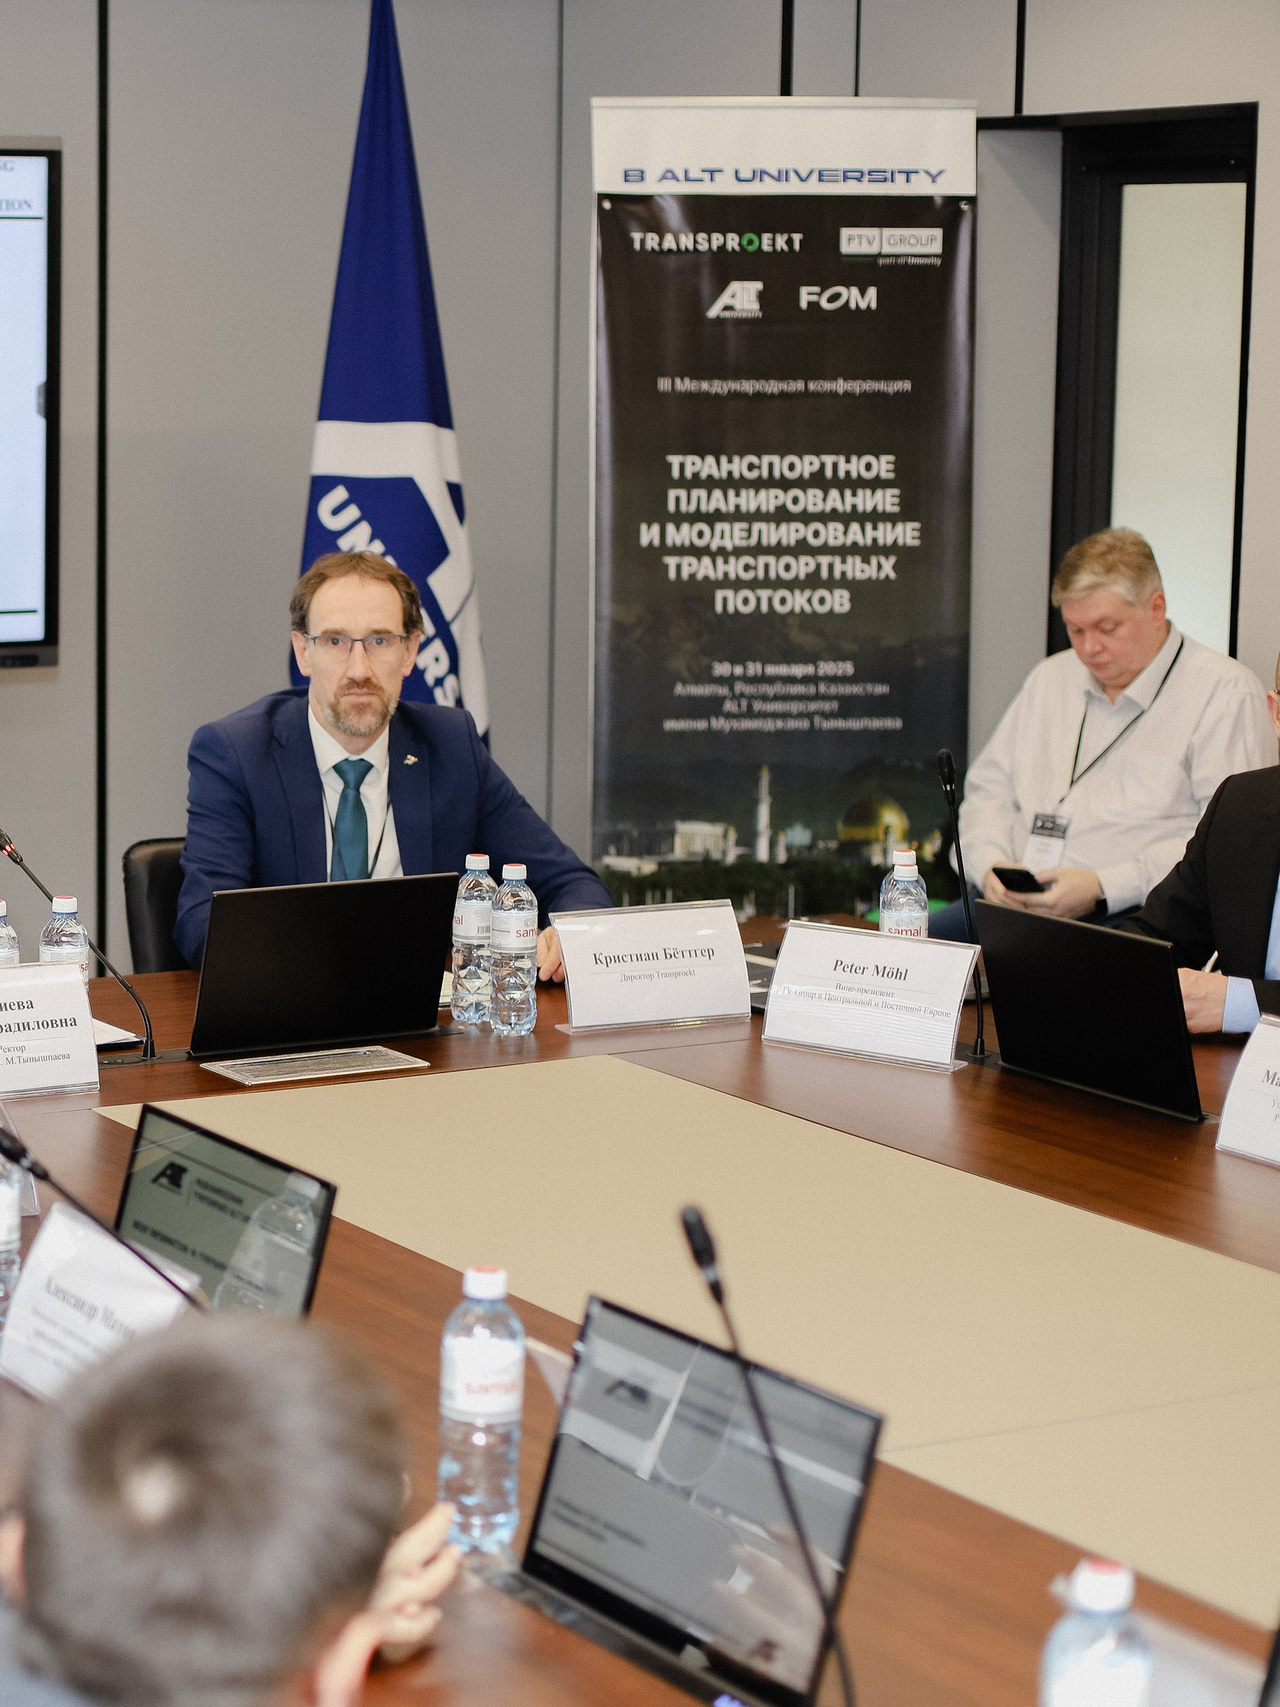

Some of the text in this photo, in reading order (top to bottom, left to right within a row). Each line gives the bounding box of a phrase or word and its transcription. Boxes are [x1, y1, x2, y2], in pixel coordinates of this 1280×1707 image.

[657, 168, 725, 183] ALT
[734, 168, 946, 184] UNIVERSITY
[630, 231, 804, 252] TRANSPROEKT
[846, 233, 938, 247] PTV GROUP
[799, 285, 877, 311] FOM
[674, 376, 805, 396] Международная
[808, 376, 912, 396] конференция
[665, 454, 897, 480] ТРАНСПОРТНОЕ
[666, 487, 901, 513] ПЛАНИРОВАНИЕ
[639, 521, 922, 551] И МОДЕЛИРОВАНИЕ
[662, 555, 897, 581] ТРАНСПОРТНЫХ
[714, 588, 851, 614] ПОТОКОВ
[593, 946, 715, 967] Кристиан Бёттгер
[620, 968, 696, 982] Директор Transproekt
[833, 959, 909, 981] Peter Möhl
[835, 982, 895, 998] Вице-президент
[794, 988, 817, 1000] Group
[823, 992, 874, 1007] Центральной
[880, 1001, 922, 1014] Восточной
[923, 1006, 952, 1019] Европе
[5, 1052, 71, 1066] М.Тынышпаева
